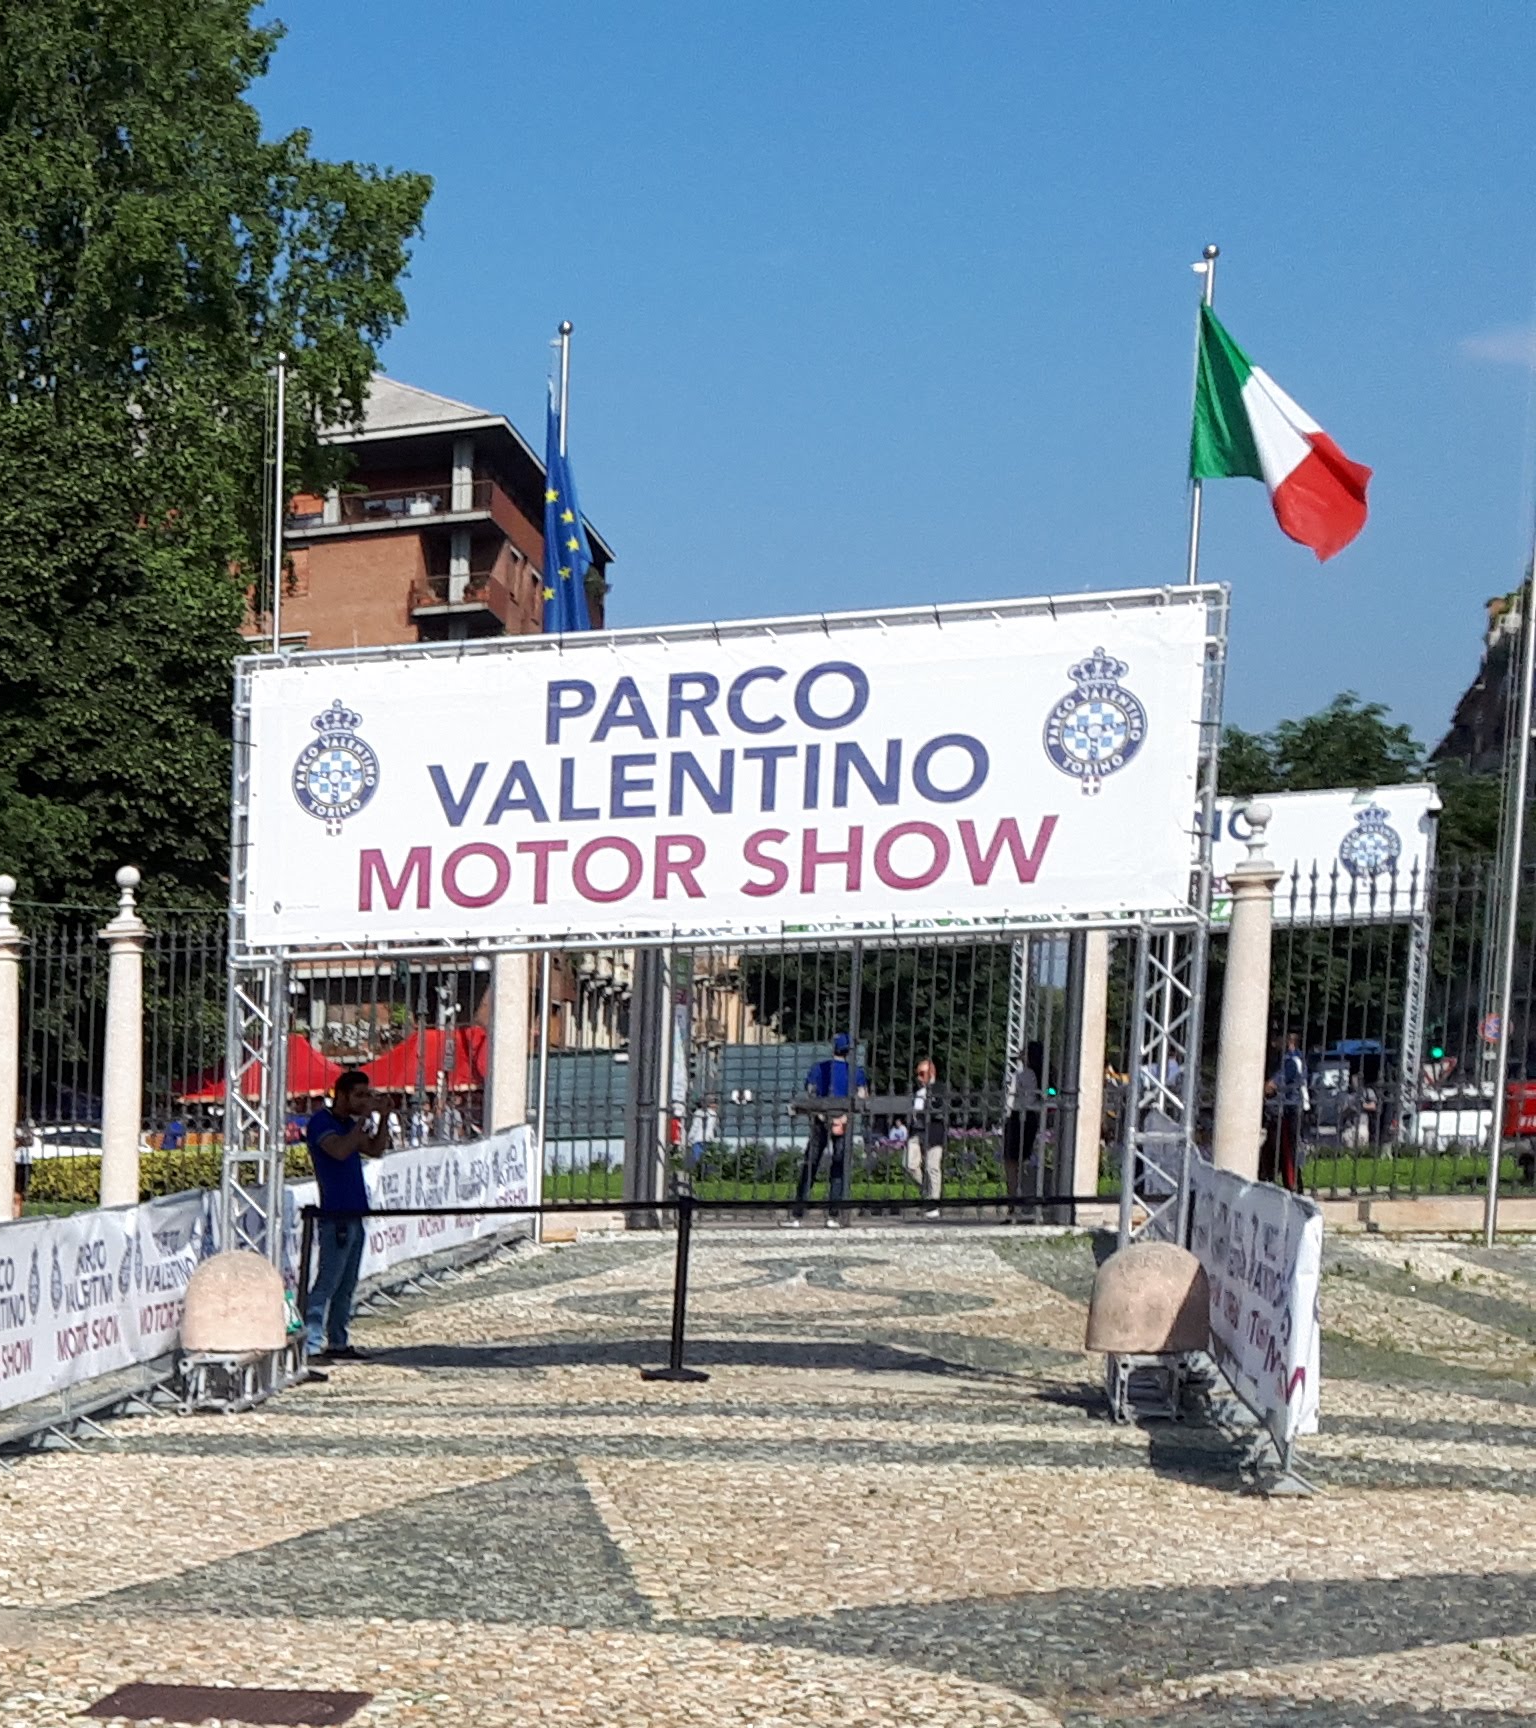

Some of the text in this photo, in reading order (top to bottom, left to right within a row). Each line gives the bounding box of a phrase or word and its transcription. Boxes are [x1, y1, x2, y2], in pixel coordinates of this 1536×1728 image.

[544, 661, 870, 746] PARCO
[1048, 685, 1143, 746] PARCO VALENTINO
[296, 734, 377, 790] PARCO VALENTINO
[426, 732, 990, 827] VALENTINO
[1062, 754, 1124, 775] TORINO
[309, 799, 361, 818] TORINO
[356, 814, 1060, 913] MOTOR SHOW
[57, 1321, 89, 1362] MOTR
